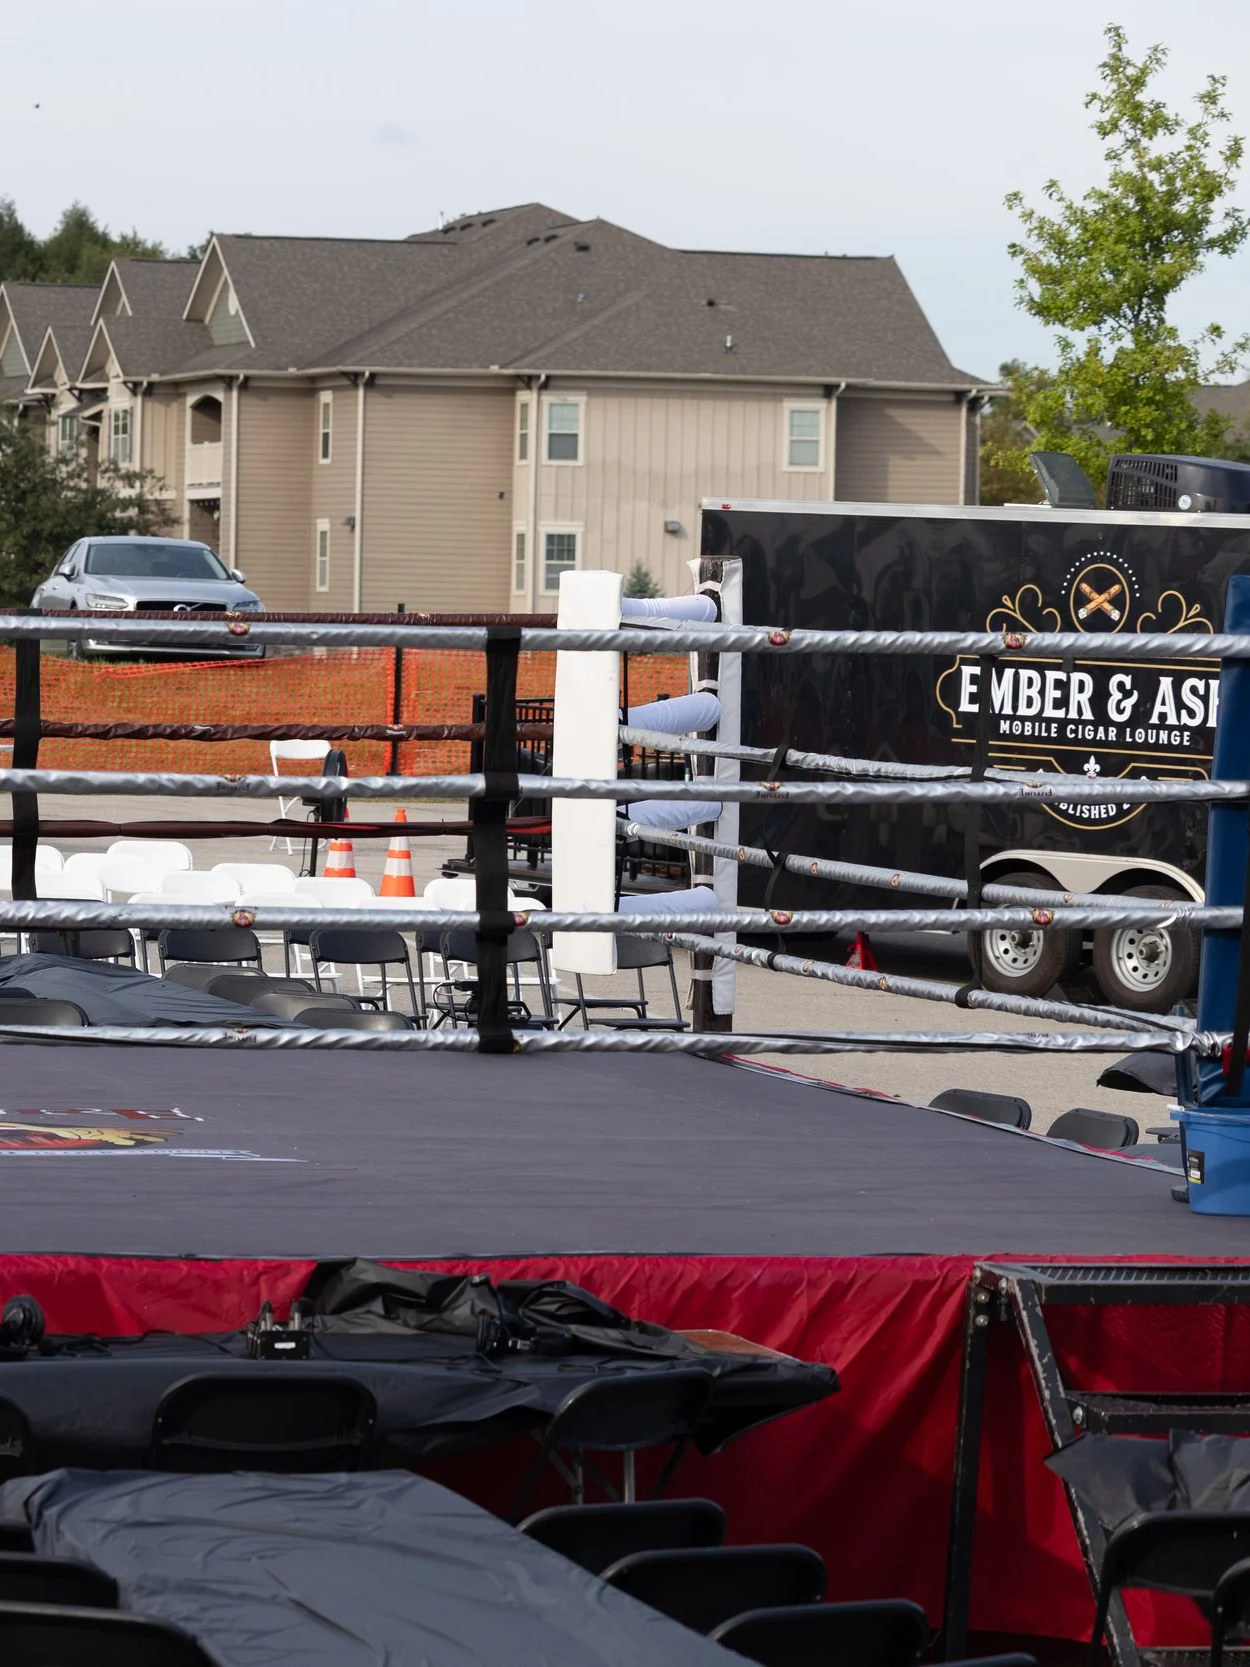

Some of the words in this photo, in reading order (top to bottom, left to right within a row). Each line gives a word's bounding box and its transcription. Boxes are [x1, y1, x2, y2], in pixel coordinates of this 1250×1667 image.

[957, 665, 1095, 720] EMBER
[1107, 673, 1139, 722] &
[999, 719, 1059, 738] MOBILE
[1066, 724, 1117, 741] CIGAR
[1125, 727, 1191, 746] LOUNGE
